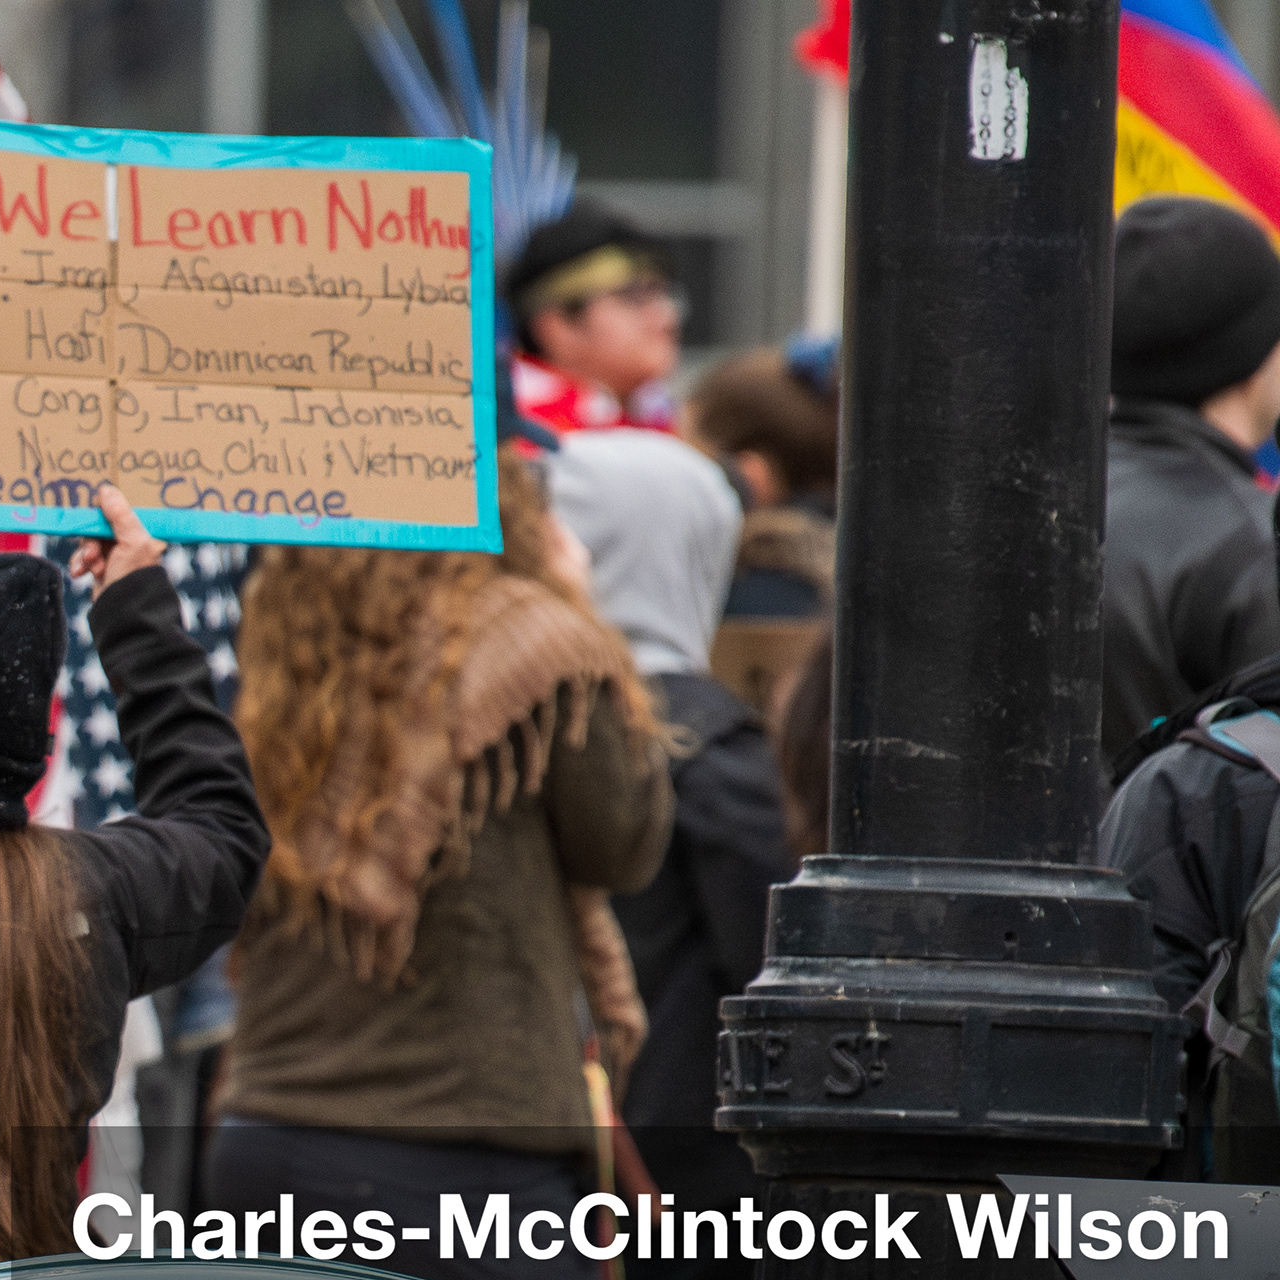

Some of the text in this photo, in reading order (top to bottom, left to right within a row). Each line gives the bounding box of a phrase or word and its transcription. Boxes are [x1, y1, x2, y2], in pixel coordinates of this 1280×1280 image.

[128, 166, 308, 251] Learn
[118, 322, 314, 376] Dominican
[156, 386, 269, 439] Iran,
[160, 477, 353, 528] Change
